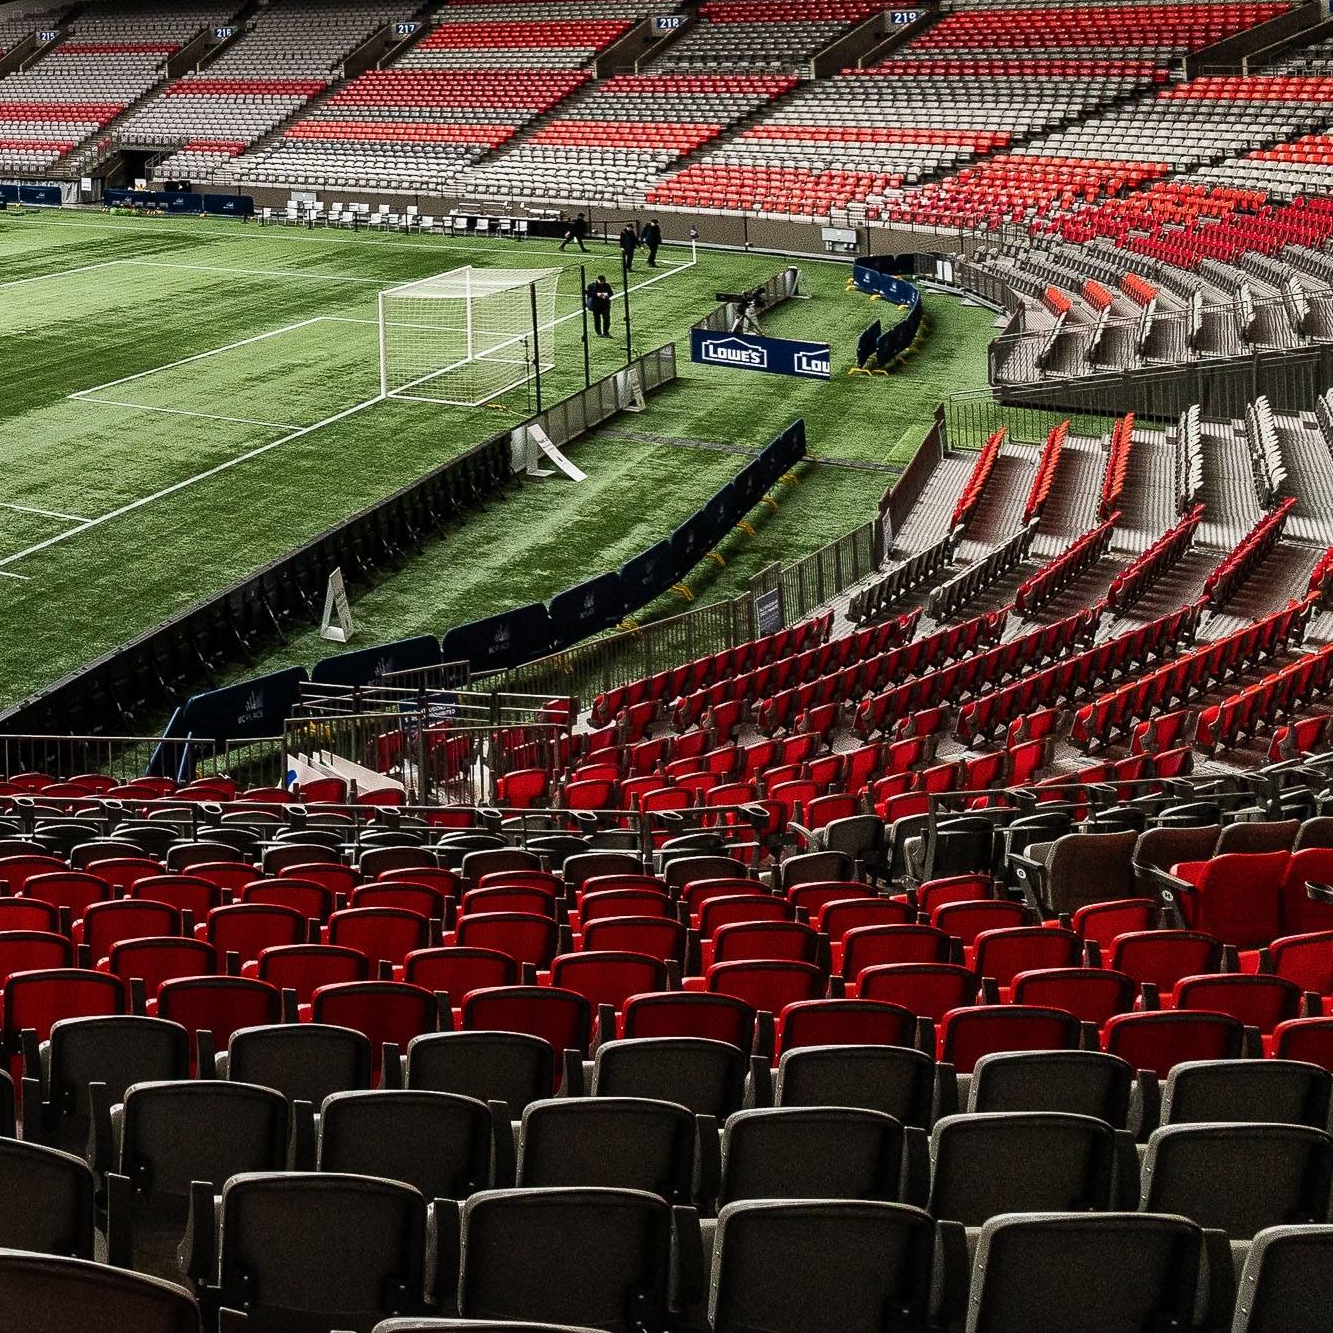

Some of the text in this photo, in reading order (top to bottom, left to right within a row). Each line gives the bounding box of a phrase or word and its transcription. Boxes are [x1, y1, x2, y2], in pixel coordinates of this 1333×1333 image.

[895, 12, 916, 23] 219
[660, 18, 680, 28] 218
[397, 24, 415, 34] 217
[41, 32, 55, 41] 215
[708, 344, 761, 364] LOWE'S
